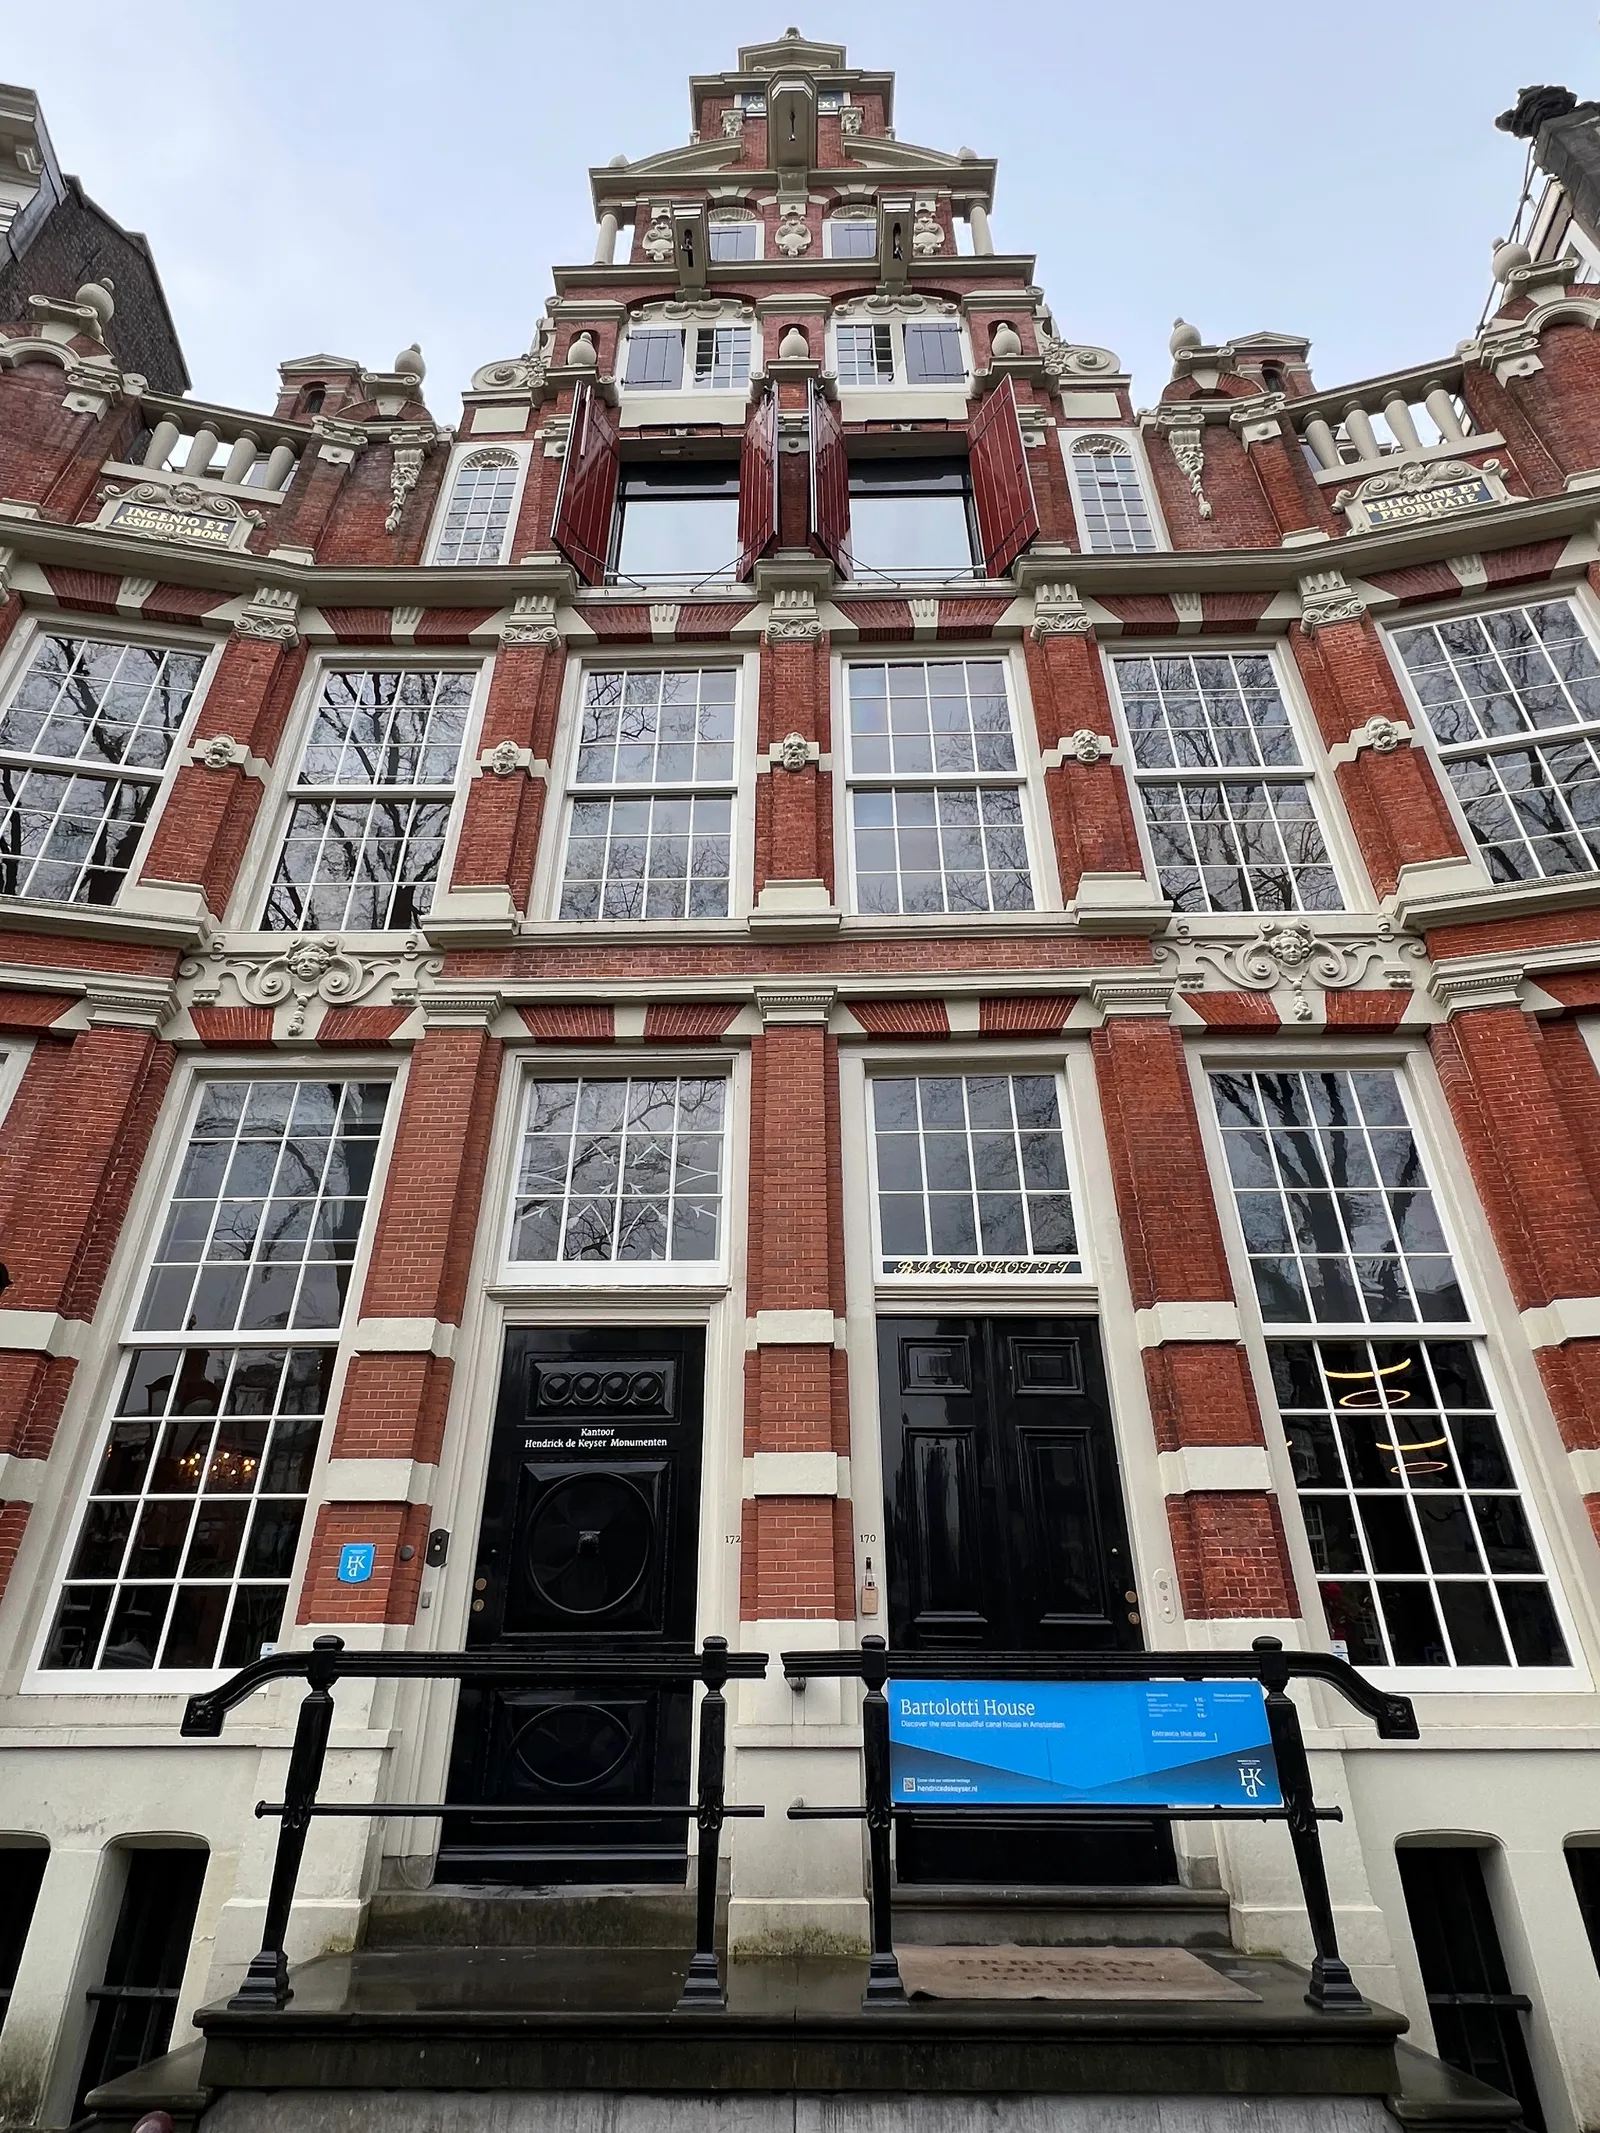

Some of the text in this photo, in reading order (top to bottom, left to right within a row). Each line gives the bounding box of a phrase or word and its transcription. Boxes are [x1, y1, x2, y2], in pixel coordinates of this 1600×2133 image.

[1364, 482, 1482, 513] RELIGIONE ET
[126, 506, 229, 531] INGENIO ET
[114, 515, 229, 542] ASSIDUO LABORE
[893, 1261, 1070, 1274] BARTOLOTTI
[581, 1428, 615, 1436] Kantoor
[525, 1438, 668, 1449] Hendrick de Keyser Monumenten
[725, 1535, 741, 1544] 172
[860, 1534, 876, 1543] 170
[900, 1697, 1036, 1716] Bartolotti House
[901, 1720, 928, 1728] Discover
[1030, 1721, 1065, 1729] Amsterdam
[1193, 1730, 1206, 1738] side
